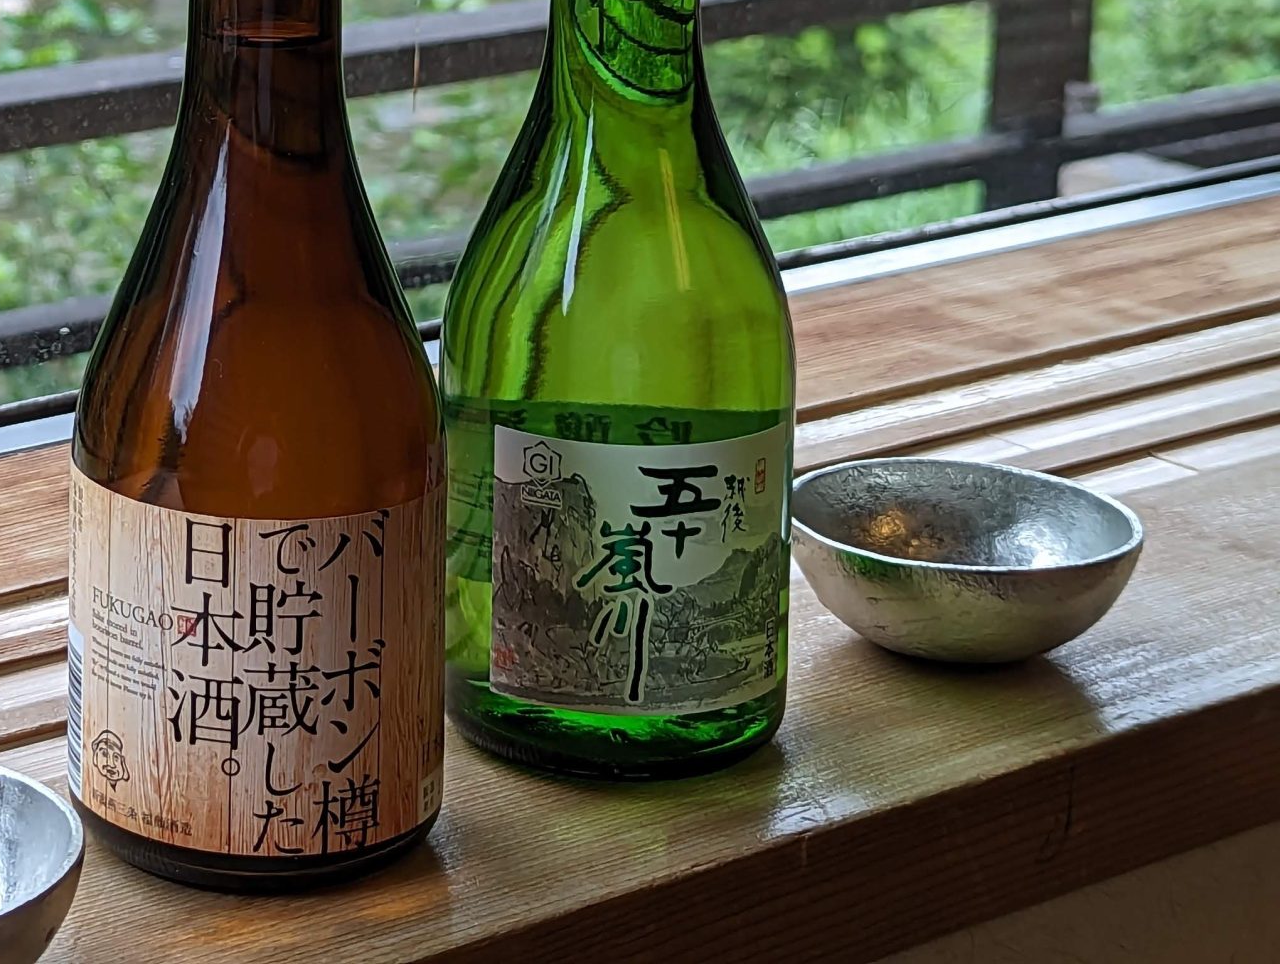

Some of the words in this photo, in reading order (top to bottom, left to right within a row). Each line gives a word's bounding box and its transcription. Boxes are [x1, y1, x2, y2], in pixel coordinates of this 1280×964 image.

[530, 453, 553, 475] GI
[92, 586, 174, 631] FUKUGAO
[167, 517, 247, 777] 日本酒。
[237, 523, 324, 854] で貯蔵した
[312, 508, 390, 855] バーボン樽
